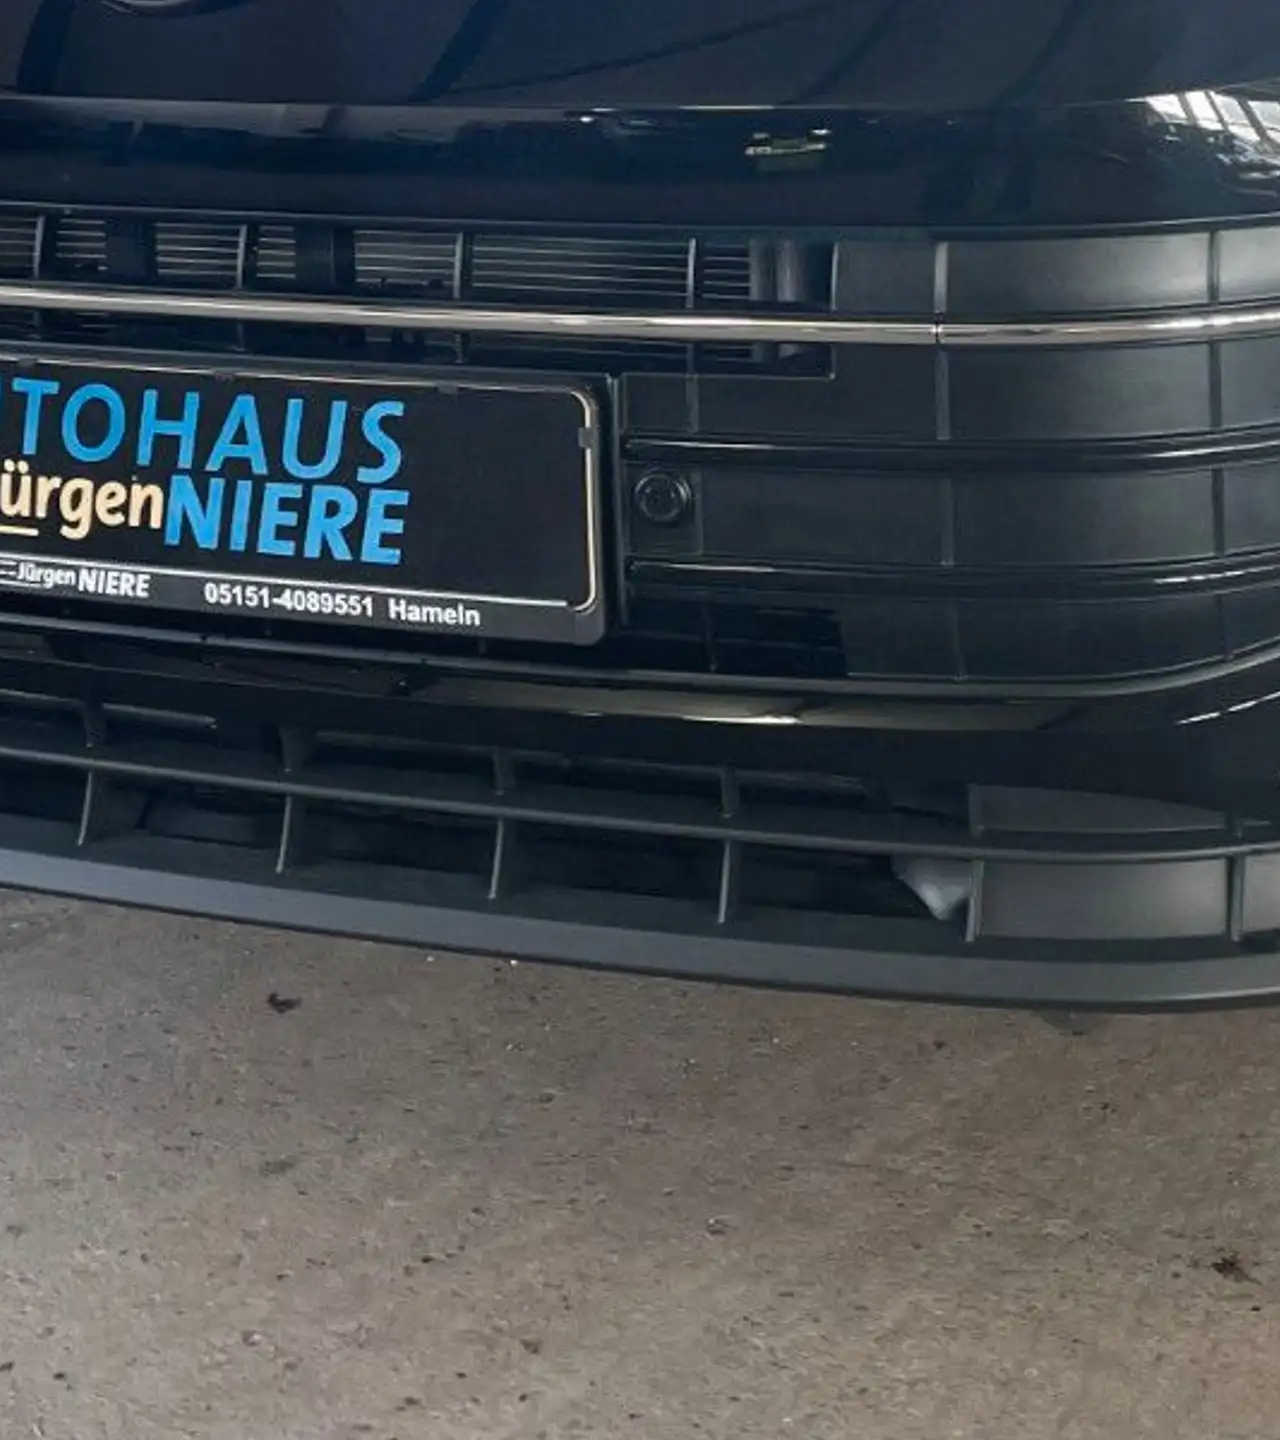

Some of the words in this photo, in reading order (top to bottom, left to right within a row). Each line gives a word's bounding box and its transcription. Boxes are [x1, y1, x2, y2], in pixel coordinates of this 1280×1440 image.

[164, 472, 409, 565] NIERE
[17, 562, 76, 589] Jürgen
[77, 571, 150, 598] NIERE
[204, 582, 374, 617] 05151-4089551
[388, 598, 481, 627] Hameln
